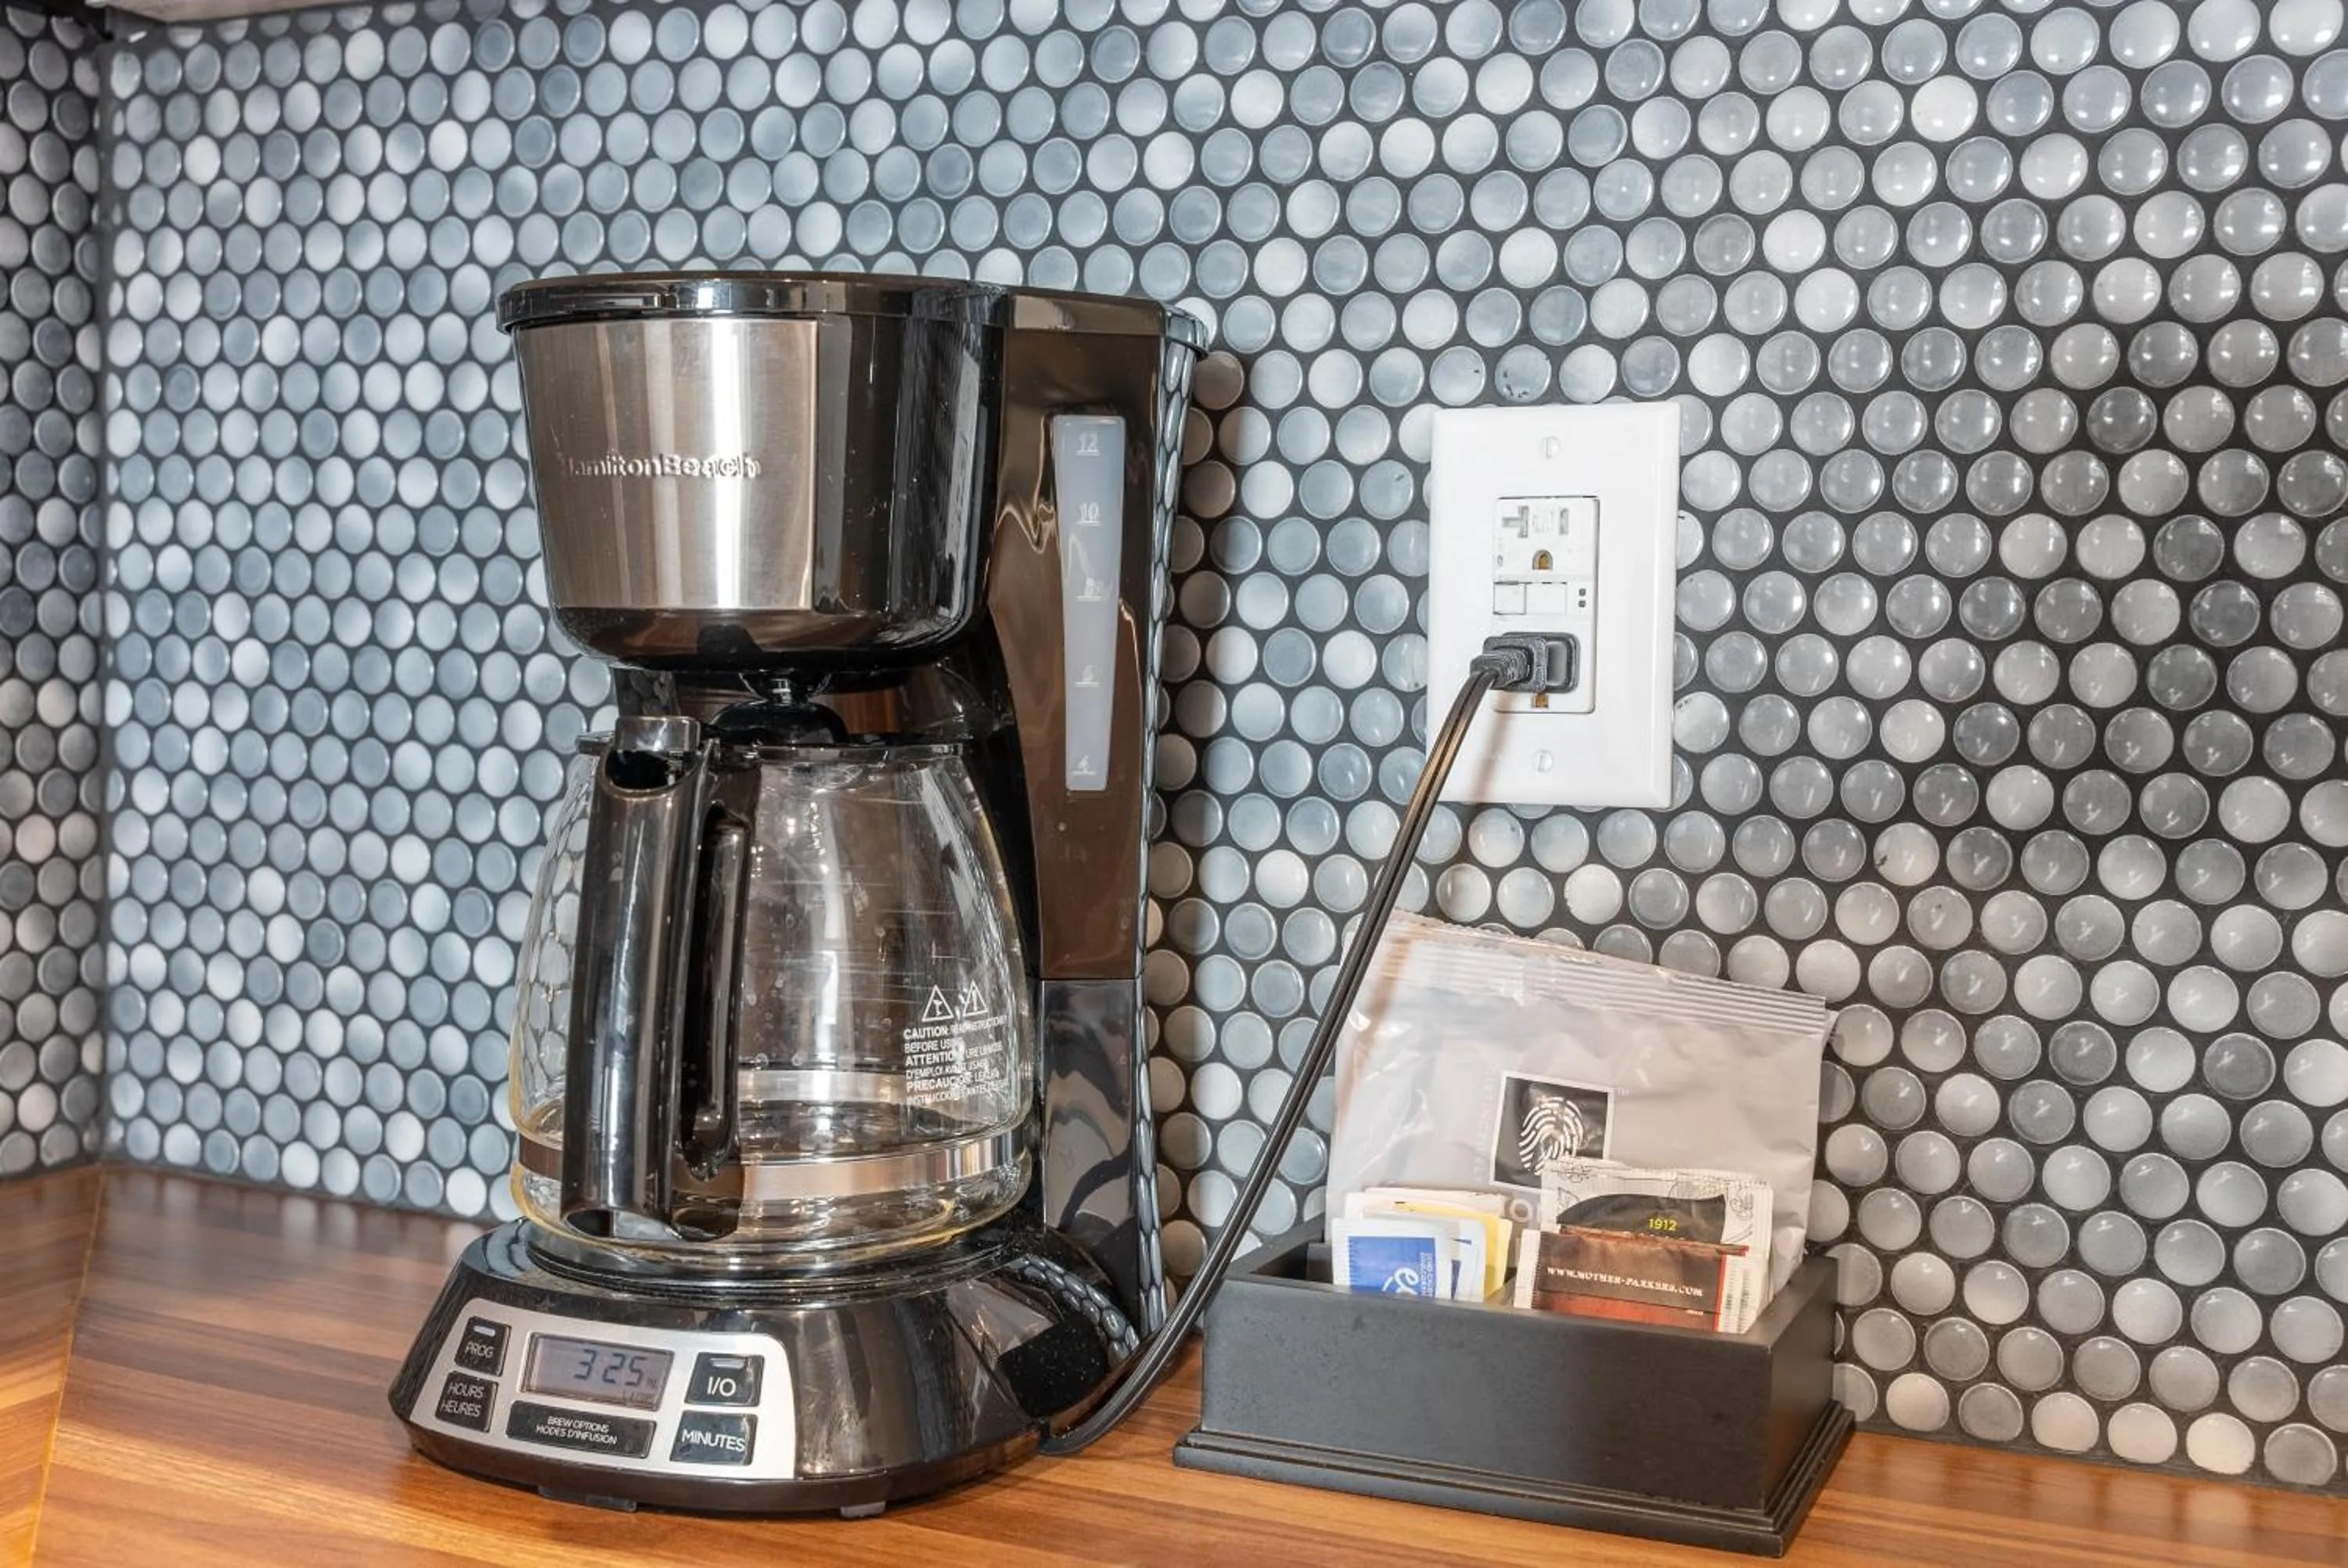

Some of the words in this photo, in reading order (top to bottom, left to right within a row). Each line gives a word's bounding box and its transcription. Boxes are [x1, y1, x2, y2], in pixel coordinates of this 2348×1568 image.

[904, 1040, 939, 1054] BEFORE
[1648, 1217, 1679, 1232] 1912
[464, 1340, 495, 1359] PROG
[447, 1381, 484, 1399] HOURS
[707, 1376, 736, 1397] I/O
[439, 1399, 482, 1418] HEURES
[547, 1415, 573, 1428] BREW
[572, 1420, 610, 1433] OPTIONS
[535, 1424, 567, 1437] MODES
[567, 1429, 618, 1446] D'INFUSION
[682, 1428, 746, 1452] MINUTES
